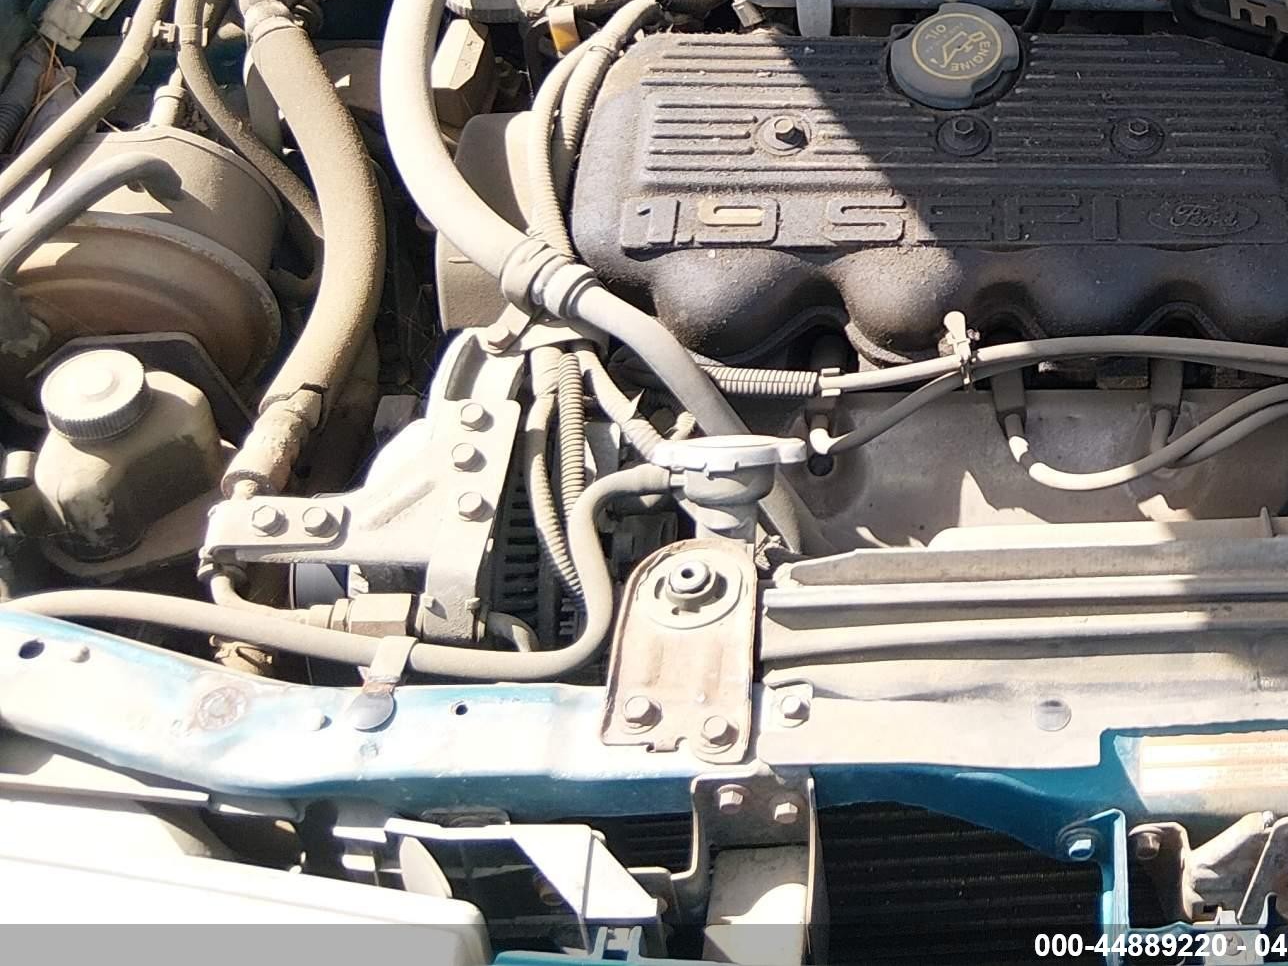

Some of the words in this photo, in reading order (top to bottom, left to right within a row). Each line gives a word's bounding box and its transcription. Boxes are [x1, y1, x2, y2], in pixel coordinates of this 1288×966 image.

[924, 24, 946, 40] OIL
[950, 40, 991, 72] ENGINE
[633, 197, 779, 244] 1.9
[826, 195, 1119, 243] SEFI
[1168, 201, 1239, 228] Ford
